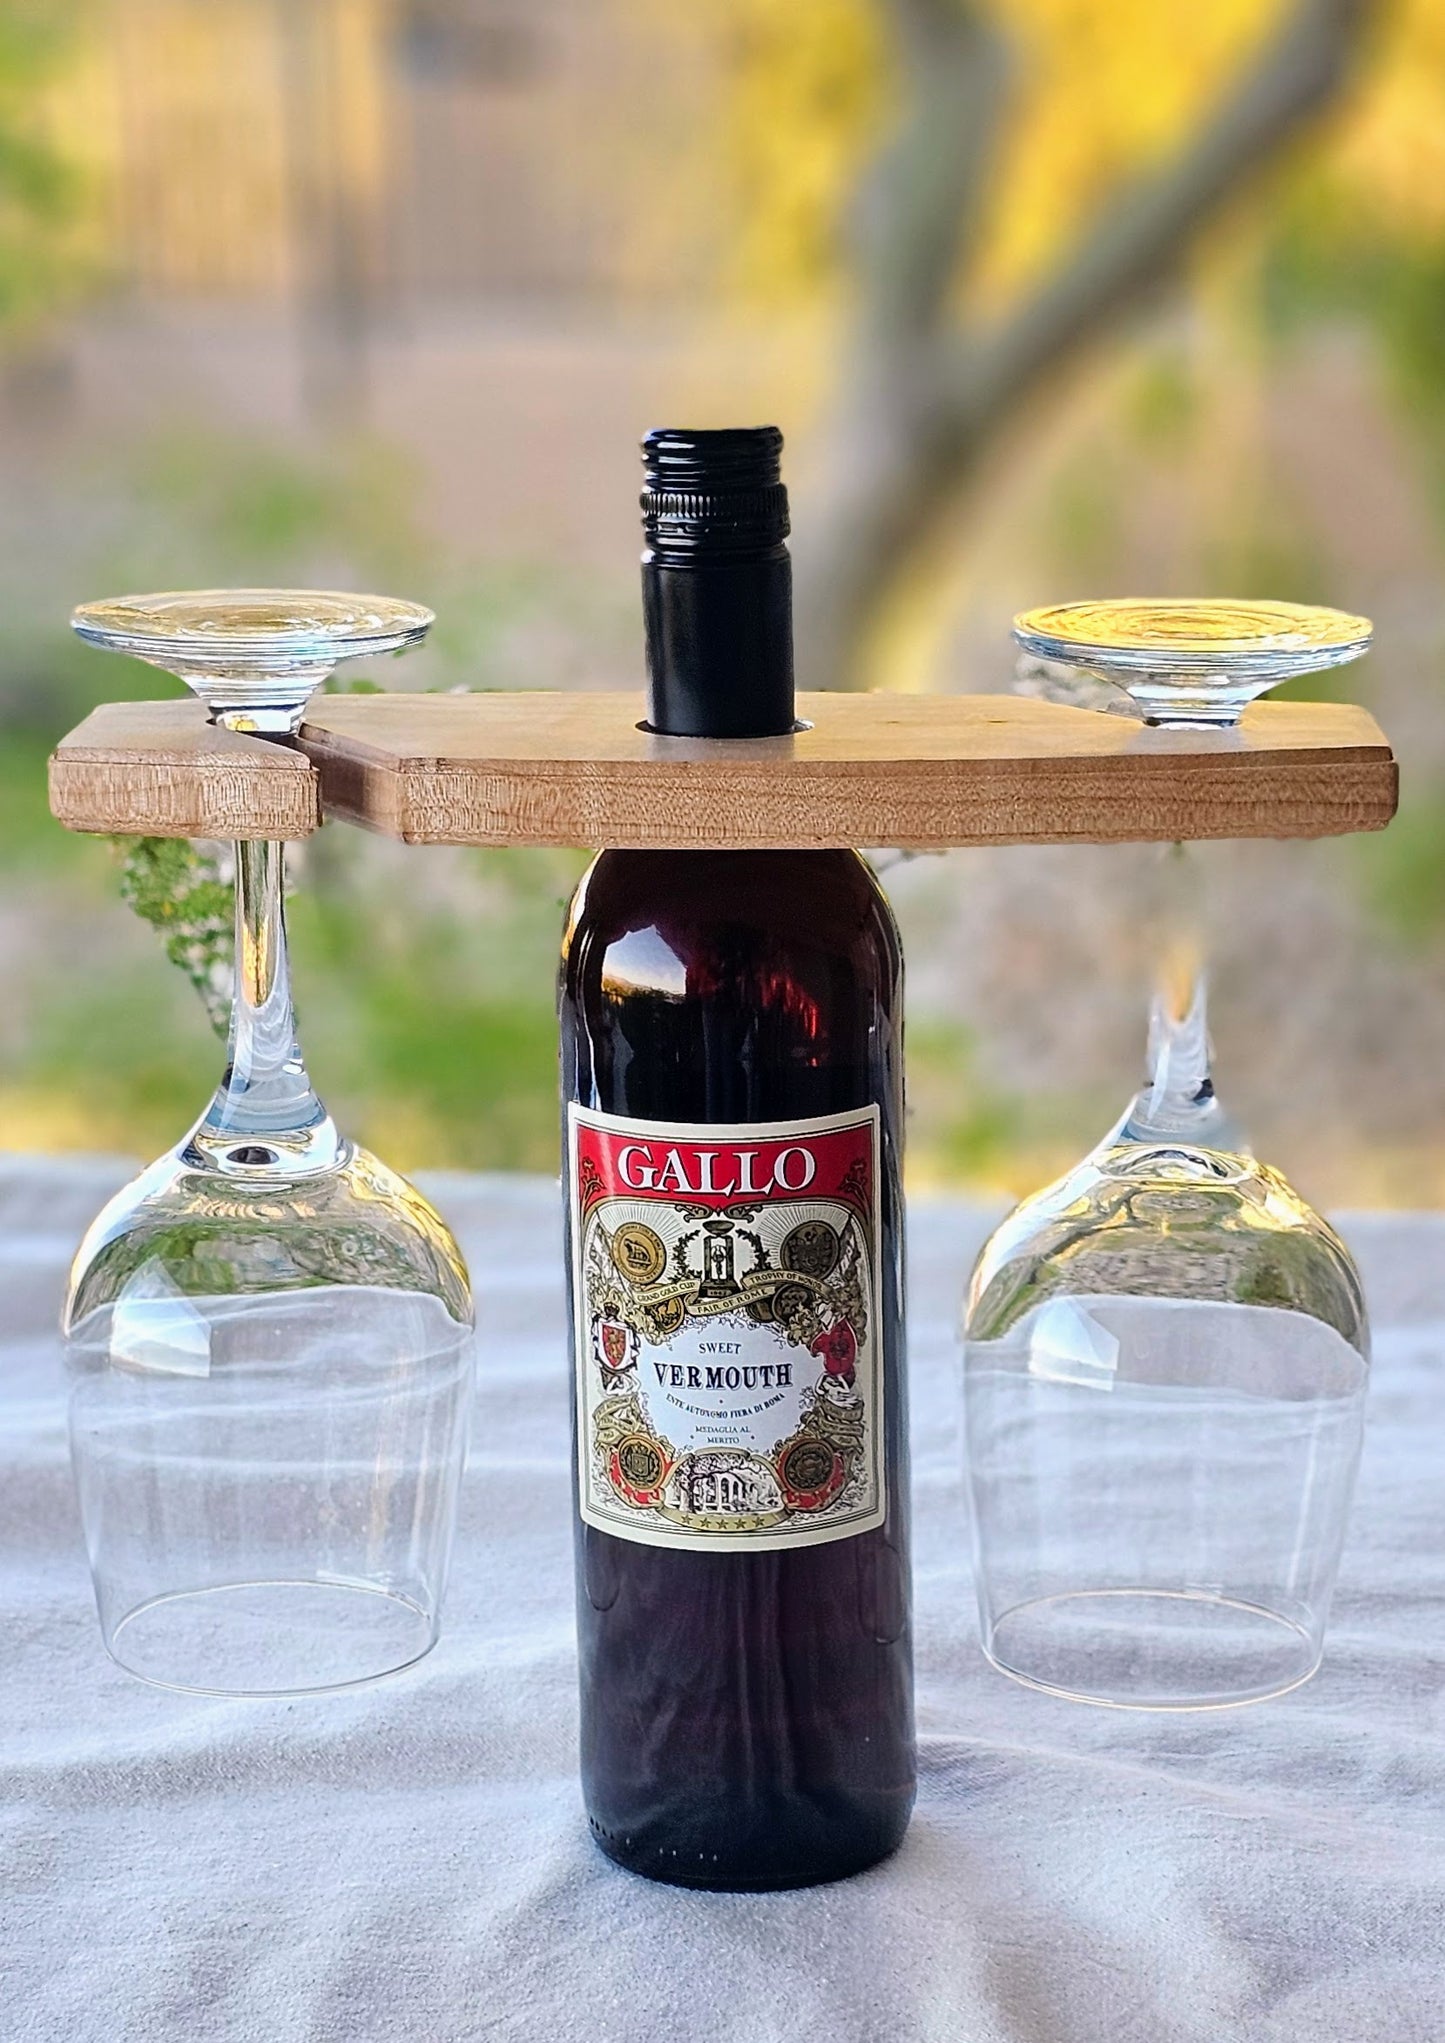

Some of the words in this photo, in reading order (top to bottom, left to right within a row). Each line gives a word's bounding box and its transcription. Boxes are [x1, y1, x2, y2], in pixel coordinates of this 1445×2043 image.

[617, 1145, 817, 1197] GALLO
[750, 1272, 784, 1285] TROPHY
[679, 1281, 697, 1290] CUP
[697, 1304, 720, 1314] FAIR
[722, 1300, 735, 1309] OF
[736, 1288, 767, 1304] ROME
[698, 1343, 742, 1355] SWEET
[653, 1362, 794, 1391] VERMOUTH
[666, 1393, 685, 1409] ENTE
[730, 1409, 753, 1419] FIERA
[754, 1405, 763, 1413] DI
[764, 1392, 786, 1409] ROMA
[695, 1425, 738, 1434] MEDAGLIA
[739, 1425, 751, 1433] AL
[707, 1436, 740, 1445] MERITO
